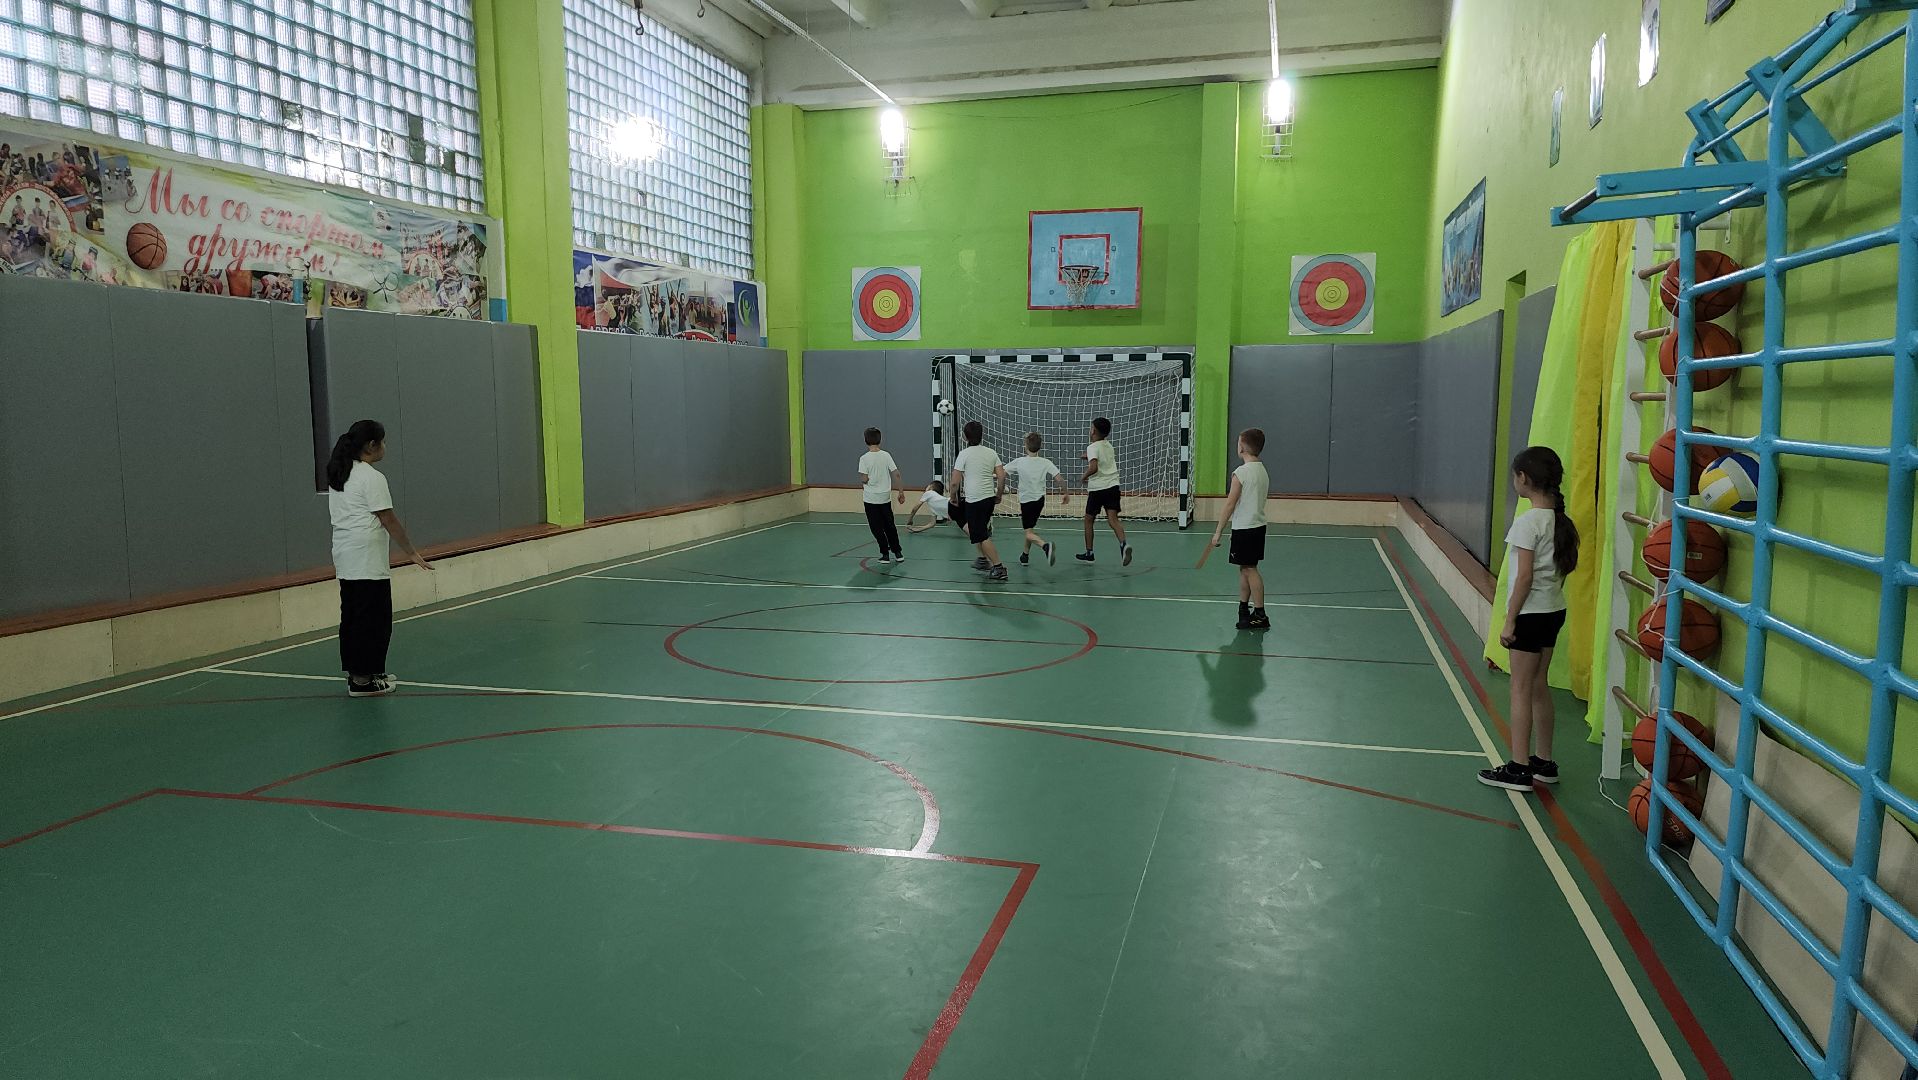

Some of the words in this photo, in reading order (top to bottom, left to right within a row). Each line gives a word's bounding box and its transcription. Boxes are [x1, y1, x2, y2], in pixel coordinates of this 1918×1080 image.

[125, 166, 210, 217] Мы
[221, 199, 251, 222] со
[260, 206, 386, 259] спортом
